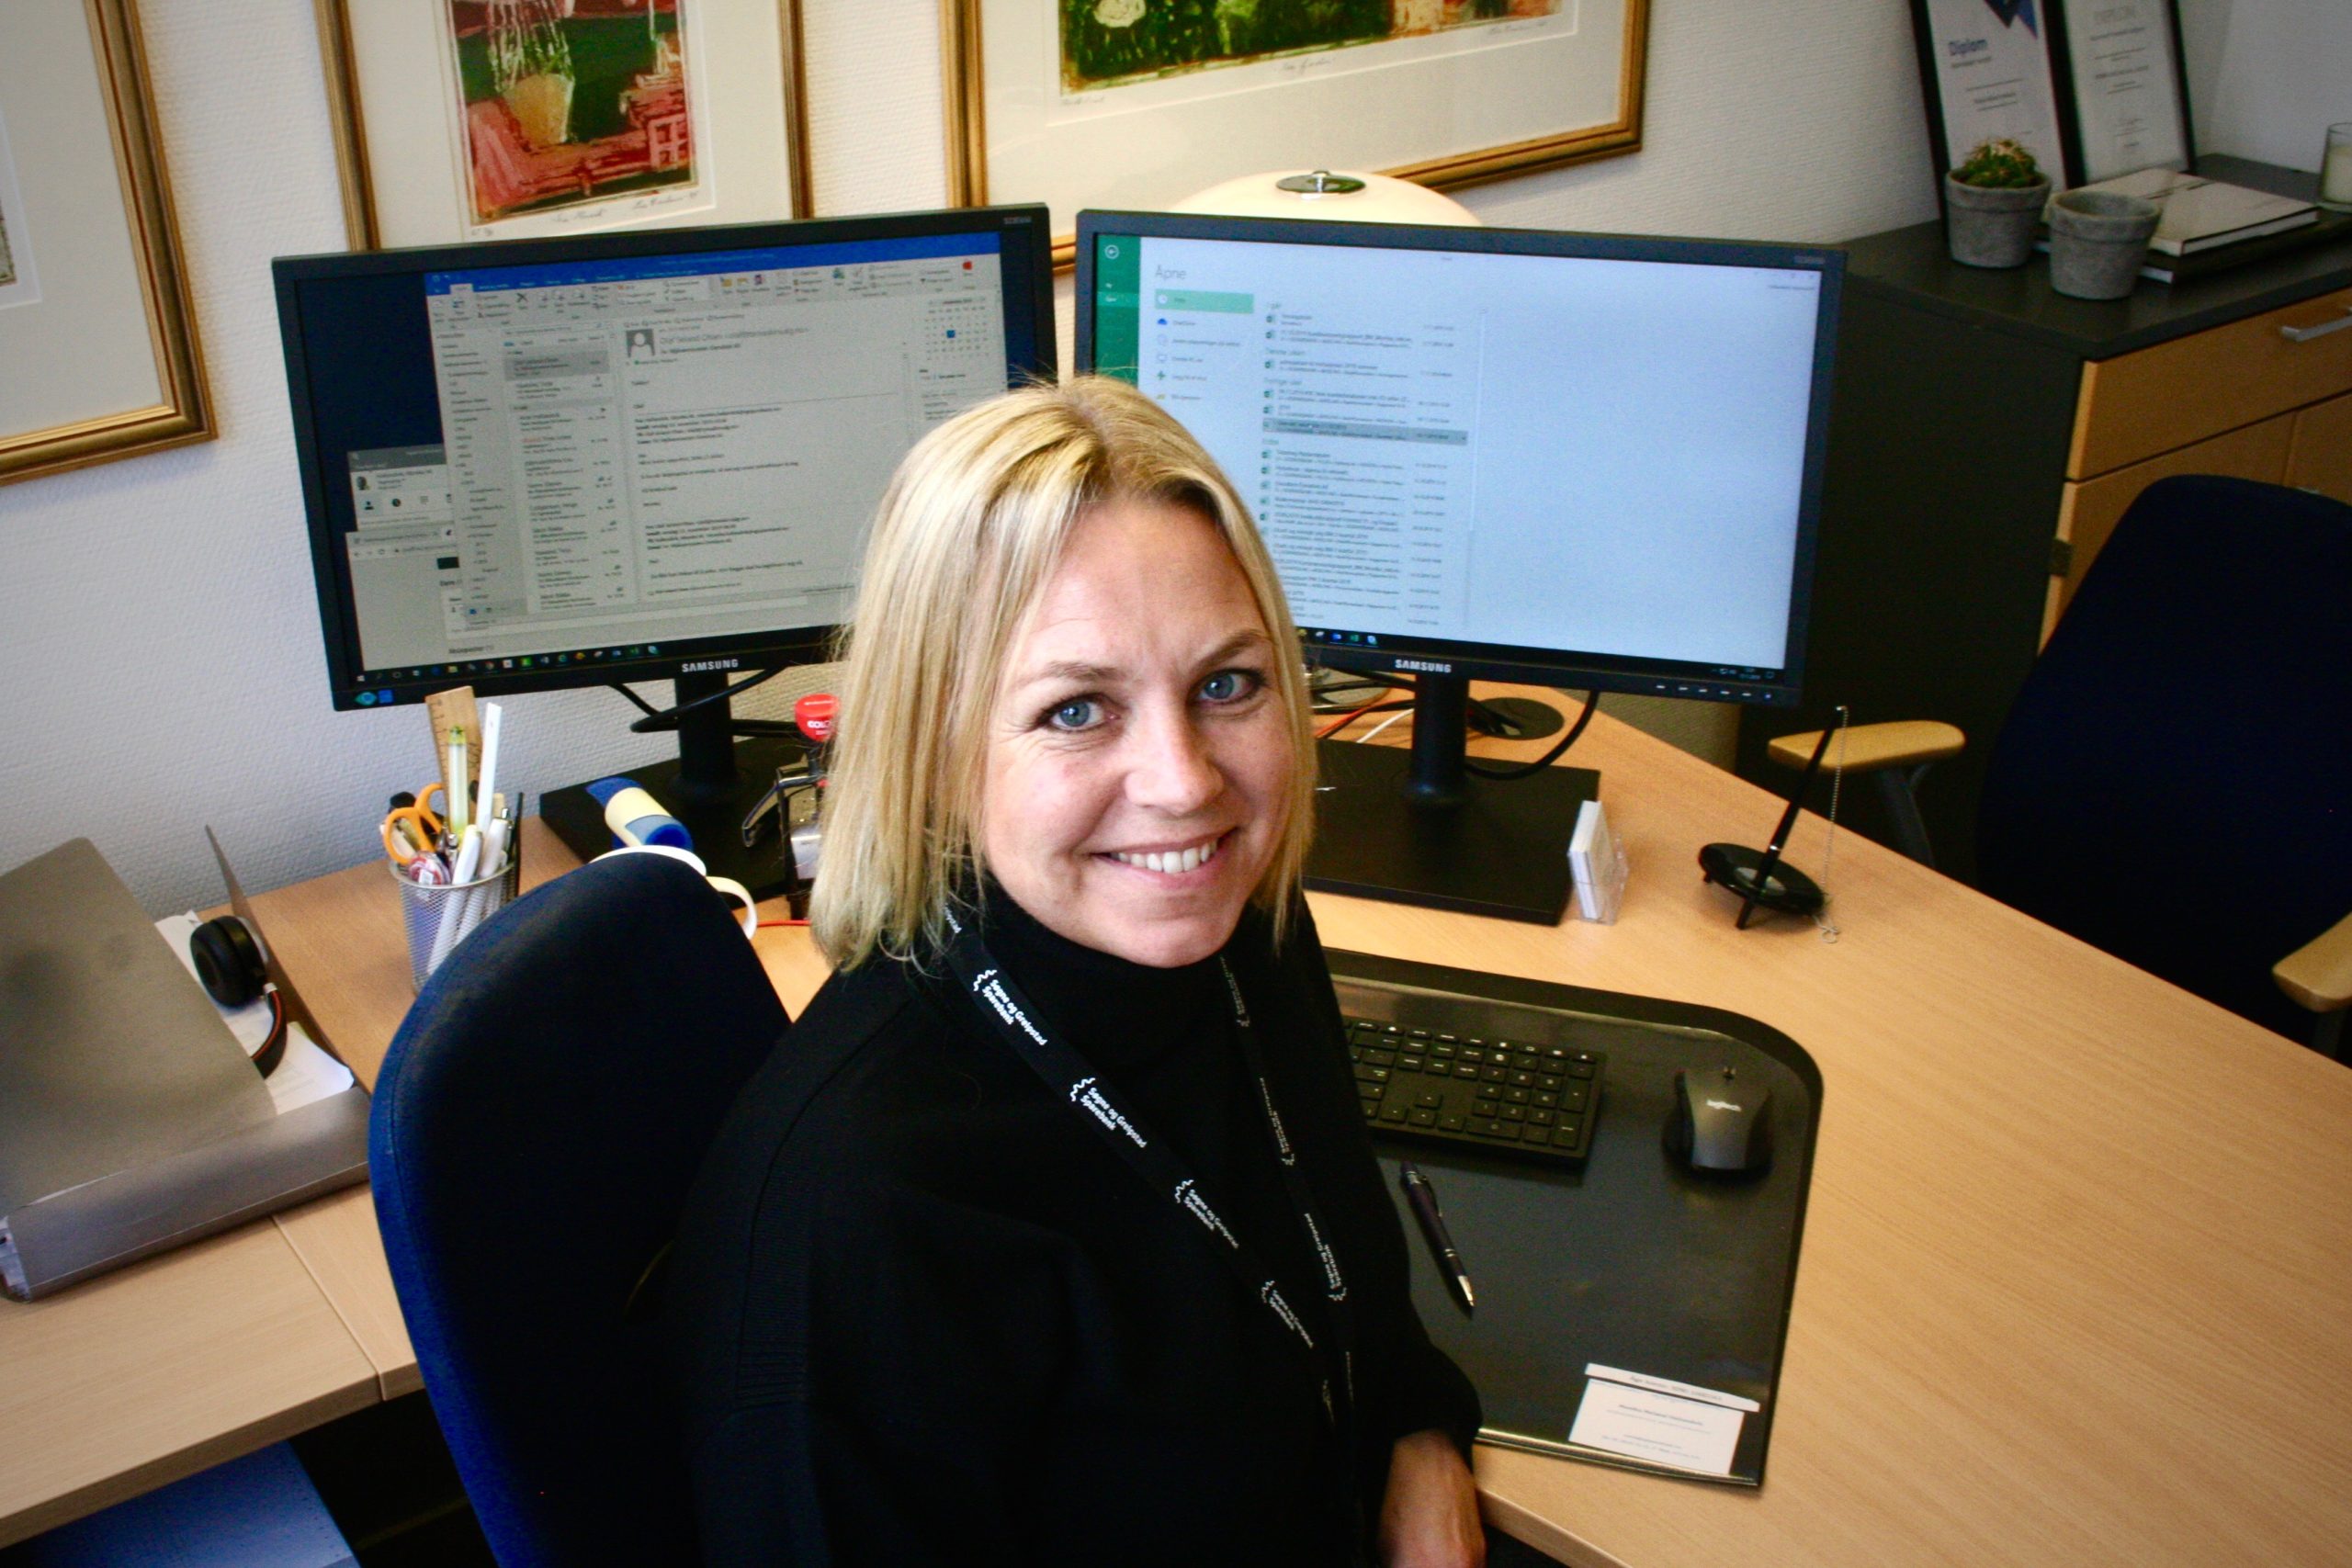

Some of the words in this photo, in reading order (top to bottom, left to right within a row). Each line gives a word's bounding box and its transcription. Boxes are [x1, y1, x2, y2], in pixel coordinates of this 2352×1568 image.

[1949, 39, 1987, 56] Diplom
[1155, 265, 1187, 280] Åpne
[682, 659, 739, 672] SAMSUNG
[1395, 660, 1452, 673] SAMSUNG
[982, 986, 1015, 1024] Sparebank
[1006, 1002, 1017, 1015] og
[1080, 1094, 1115, 1130] Sparebank
[1108, 1108, 1119, 1120] og
